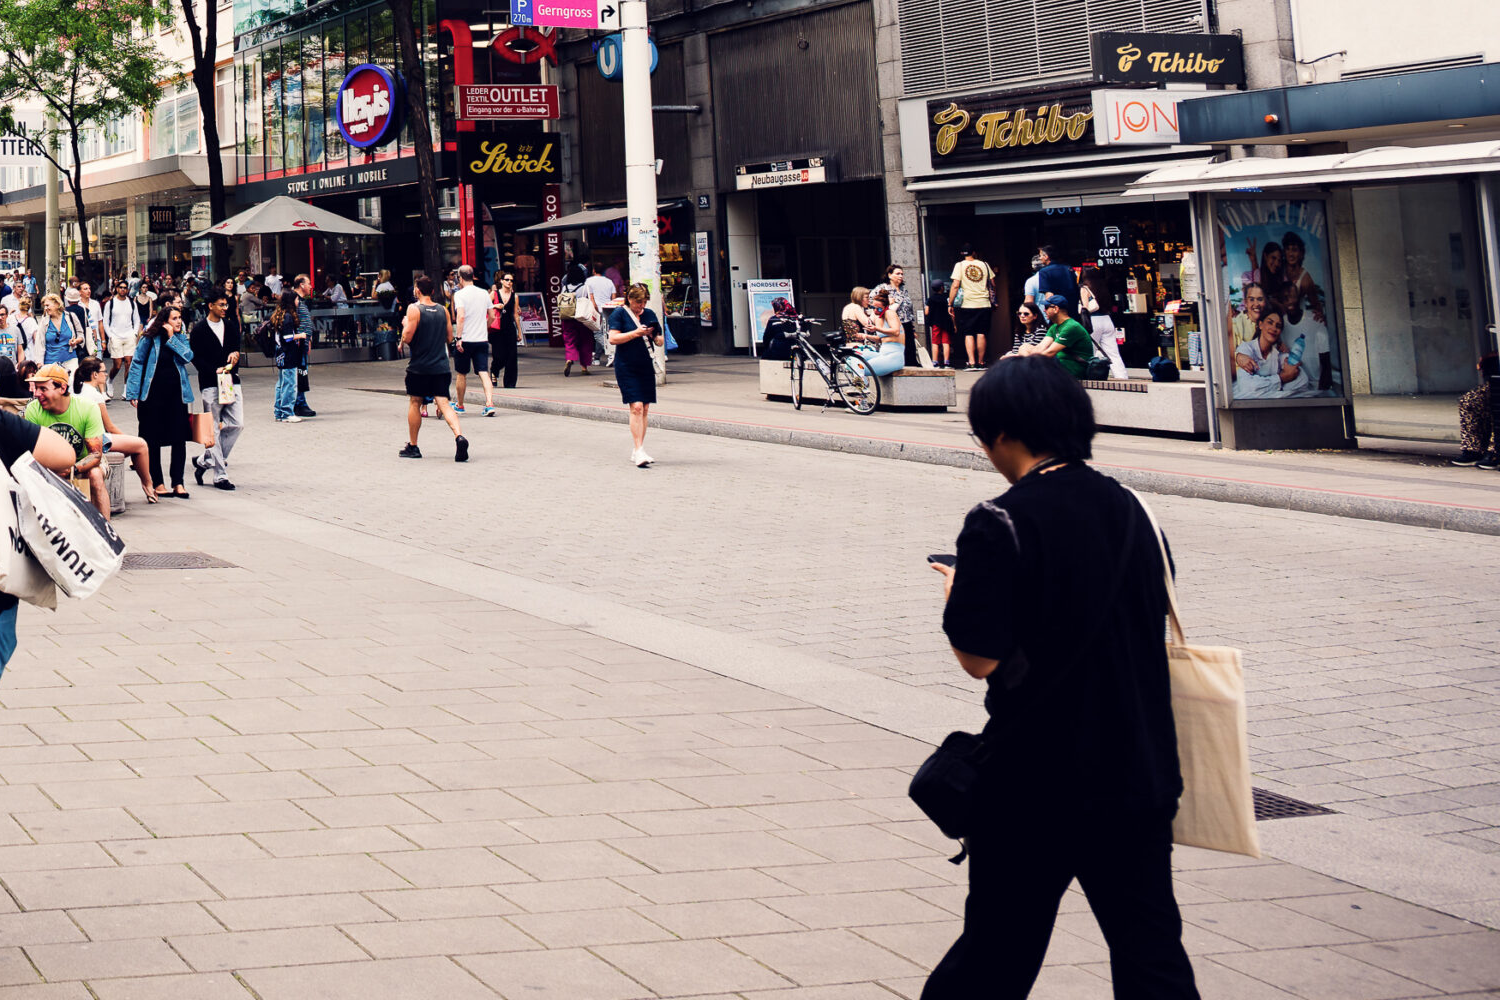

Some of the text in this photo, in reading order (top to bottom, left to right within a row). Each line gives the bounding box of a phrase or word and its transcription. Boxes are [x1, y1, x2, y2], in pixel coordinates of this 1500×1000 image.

[537, 3, 593, 19] Gerngross
[1148, 51, 1225, 74] Tchibo
[466, 87, 548, 103] LEDER OUTLET
[466, 95, 490, 103] TEXTIL
[468, 105, 492, 115] Eingang
[503, 105, 513, 113] der
[976, 103, 1094, 150] Tchibo
[469, 140, 555, 174] Ströck
[287, 168, 388, 194] STORE ONLINE MOBILE
[751, 172, 801, 185] Neubaugasse
[546, 194, 557, 212] CO
[1098, 247, 1129, 257] COFFEE
[550, 275, 560, 293] CO
[552, 306, 562, 337] WEIN
